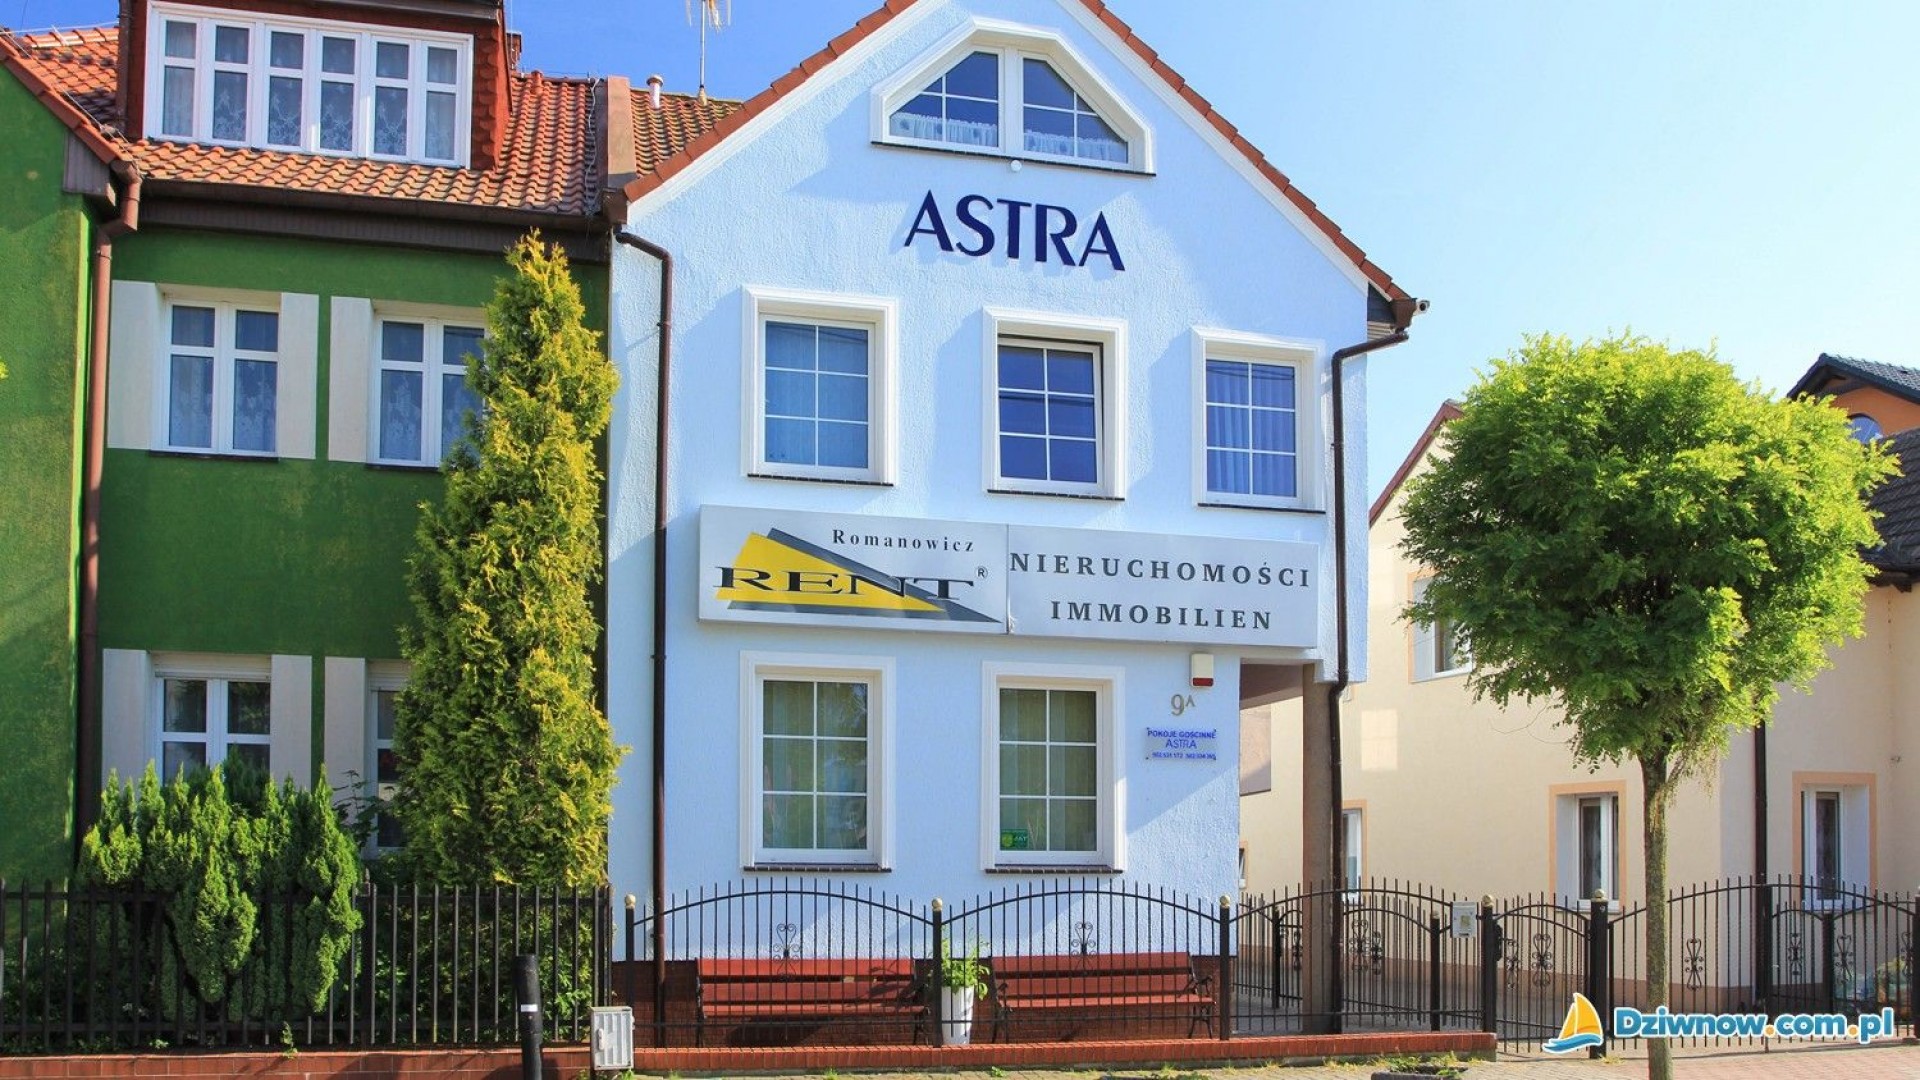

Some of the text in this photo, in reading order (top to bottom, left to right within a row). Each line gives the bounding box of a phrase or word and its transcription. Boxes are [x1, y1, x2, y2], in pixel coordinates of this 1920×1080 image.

[904, 189, 1126, 271] ASTRA
[832, 529, 974, 552] Romanowicz
[713, 566, 974, 600] RENT
[1010, 552, 1309, 587] NIERUCHOMOŚCI
[1051, 600, 1272, 629] IMMOBILIEN
[1147, 730, 1177, 738] POKOJE
[1165, 739, 1198, 749] ASTRA
